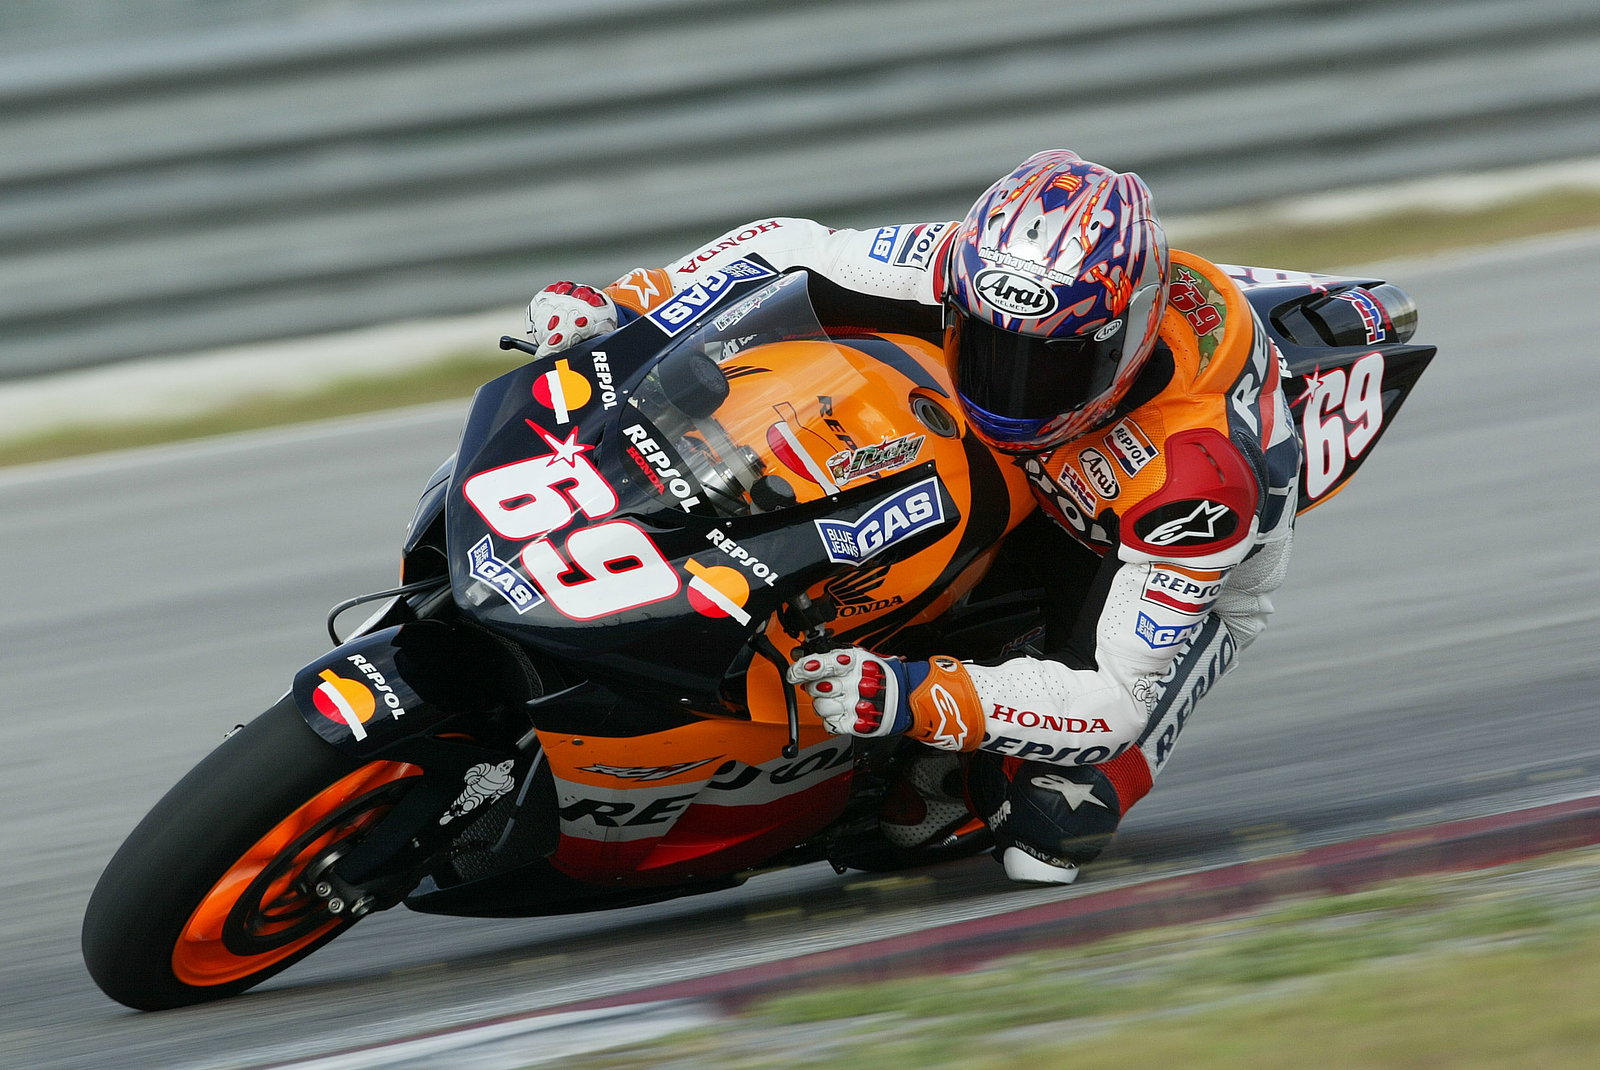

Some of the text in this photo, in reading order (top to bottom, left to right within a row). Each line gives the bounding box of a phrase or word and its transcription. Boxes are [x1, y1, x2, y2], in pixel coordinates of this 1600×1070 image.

[677, 220, 783, 274] HONDA
[872, 226, 898, 258] AS
[978, 246, 1075, 287] nickyhayden.com
[659, 271, 730, 325] GAS
[979, 275, 1046, 308] Arai
[994, 299, 1025, 312] HELMET
[1168, 282, 1223, 336] 69
[591, 351, 618, 410] REPSOL
[1303, 351, 1385, 500] 69
[622, 424, 700, 514] REPSOL
[1114, 428, 1146, 467] REPSOL
[626, 446, 665, 495] HONDA
[1081, 457, 1115, 493] Arai
[463, 452, 682, 621] 69
[826, 528, 855, 546] BLUE
[857, 492, 933, 557] GAS
[705, 528, 779, 588] REPSOL
[831, 541, 859, 558] JEANS
[476, 560, 533, 606] GAS
[1151, 572, 1222, 599] REPSO
[836, 595, 904, 618] ONDA
[1153, 627, 1192, 646] GA
[347, 653, 406, 721] REPSOL
[989, 703, 1112, 734] HONDA
